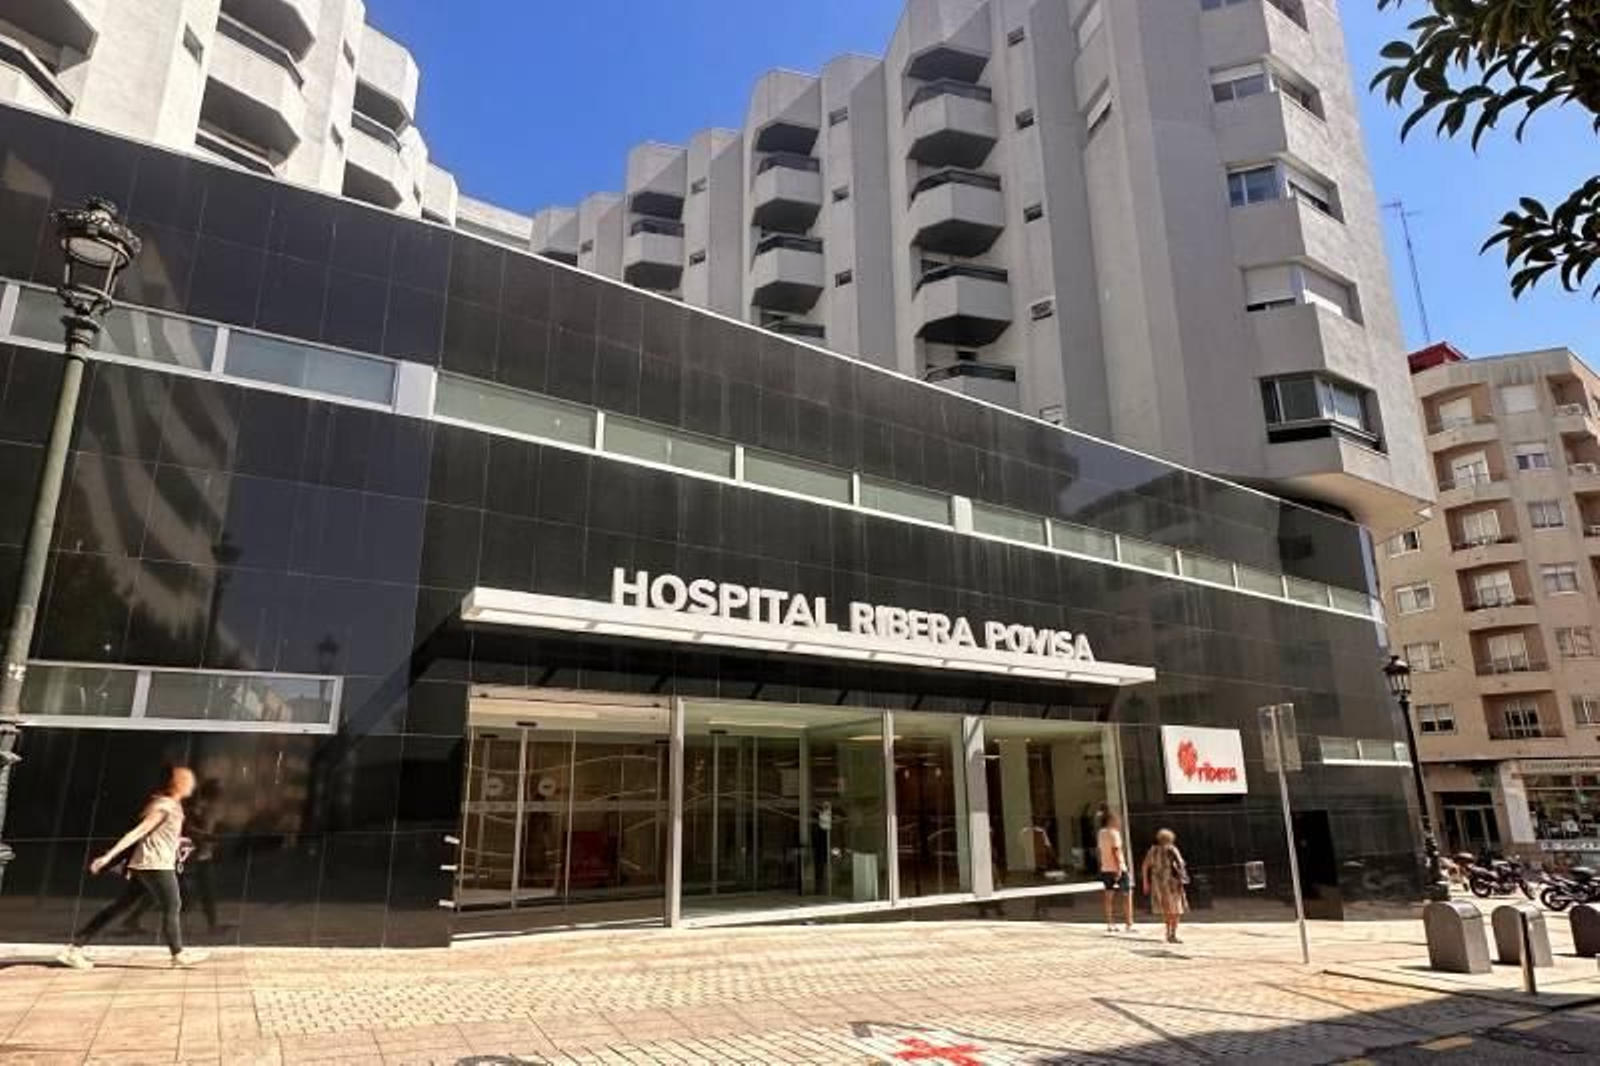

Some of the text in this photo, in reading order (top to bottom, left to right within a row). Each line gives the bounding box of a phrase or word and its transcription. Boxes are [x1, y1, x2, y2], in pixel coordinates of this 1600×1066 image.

[612, 567, 1095, 664] HOSPITAL RIBERA POVISA
[1197, 762, 1238, 782] ribera
